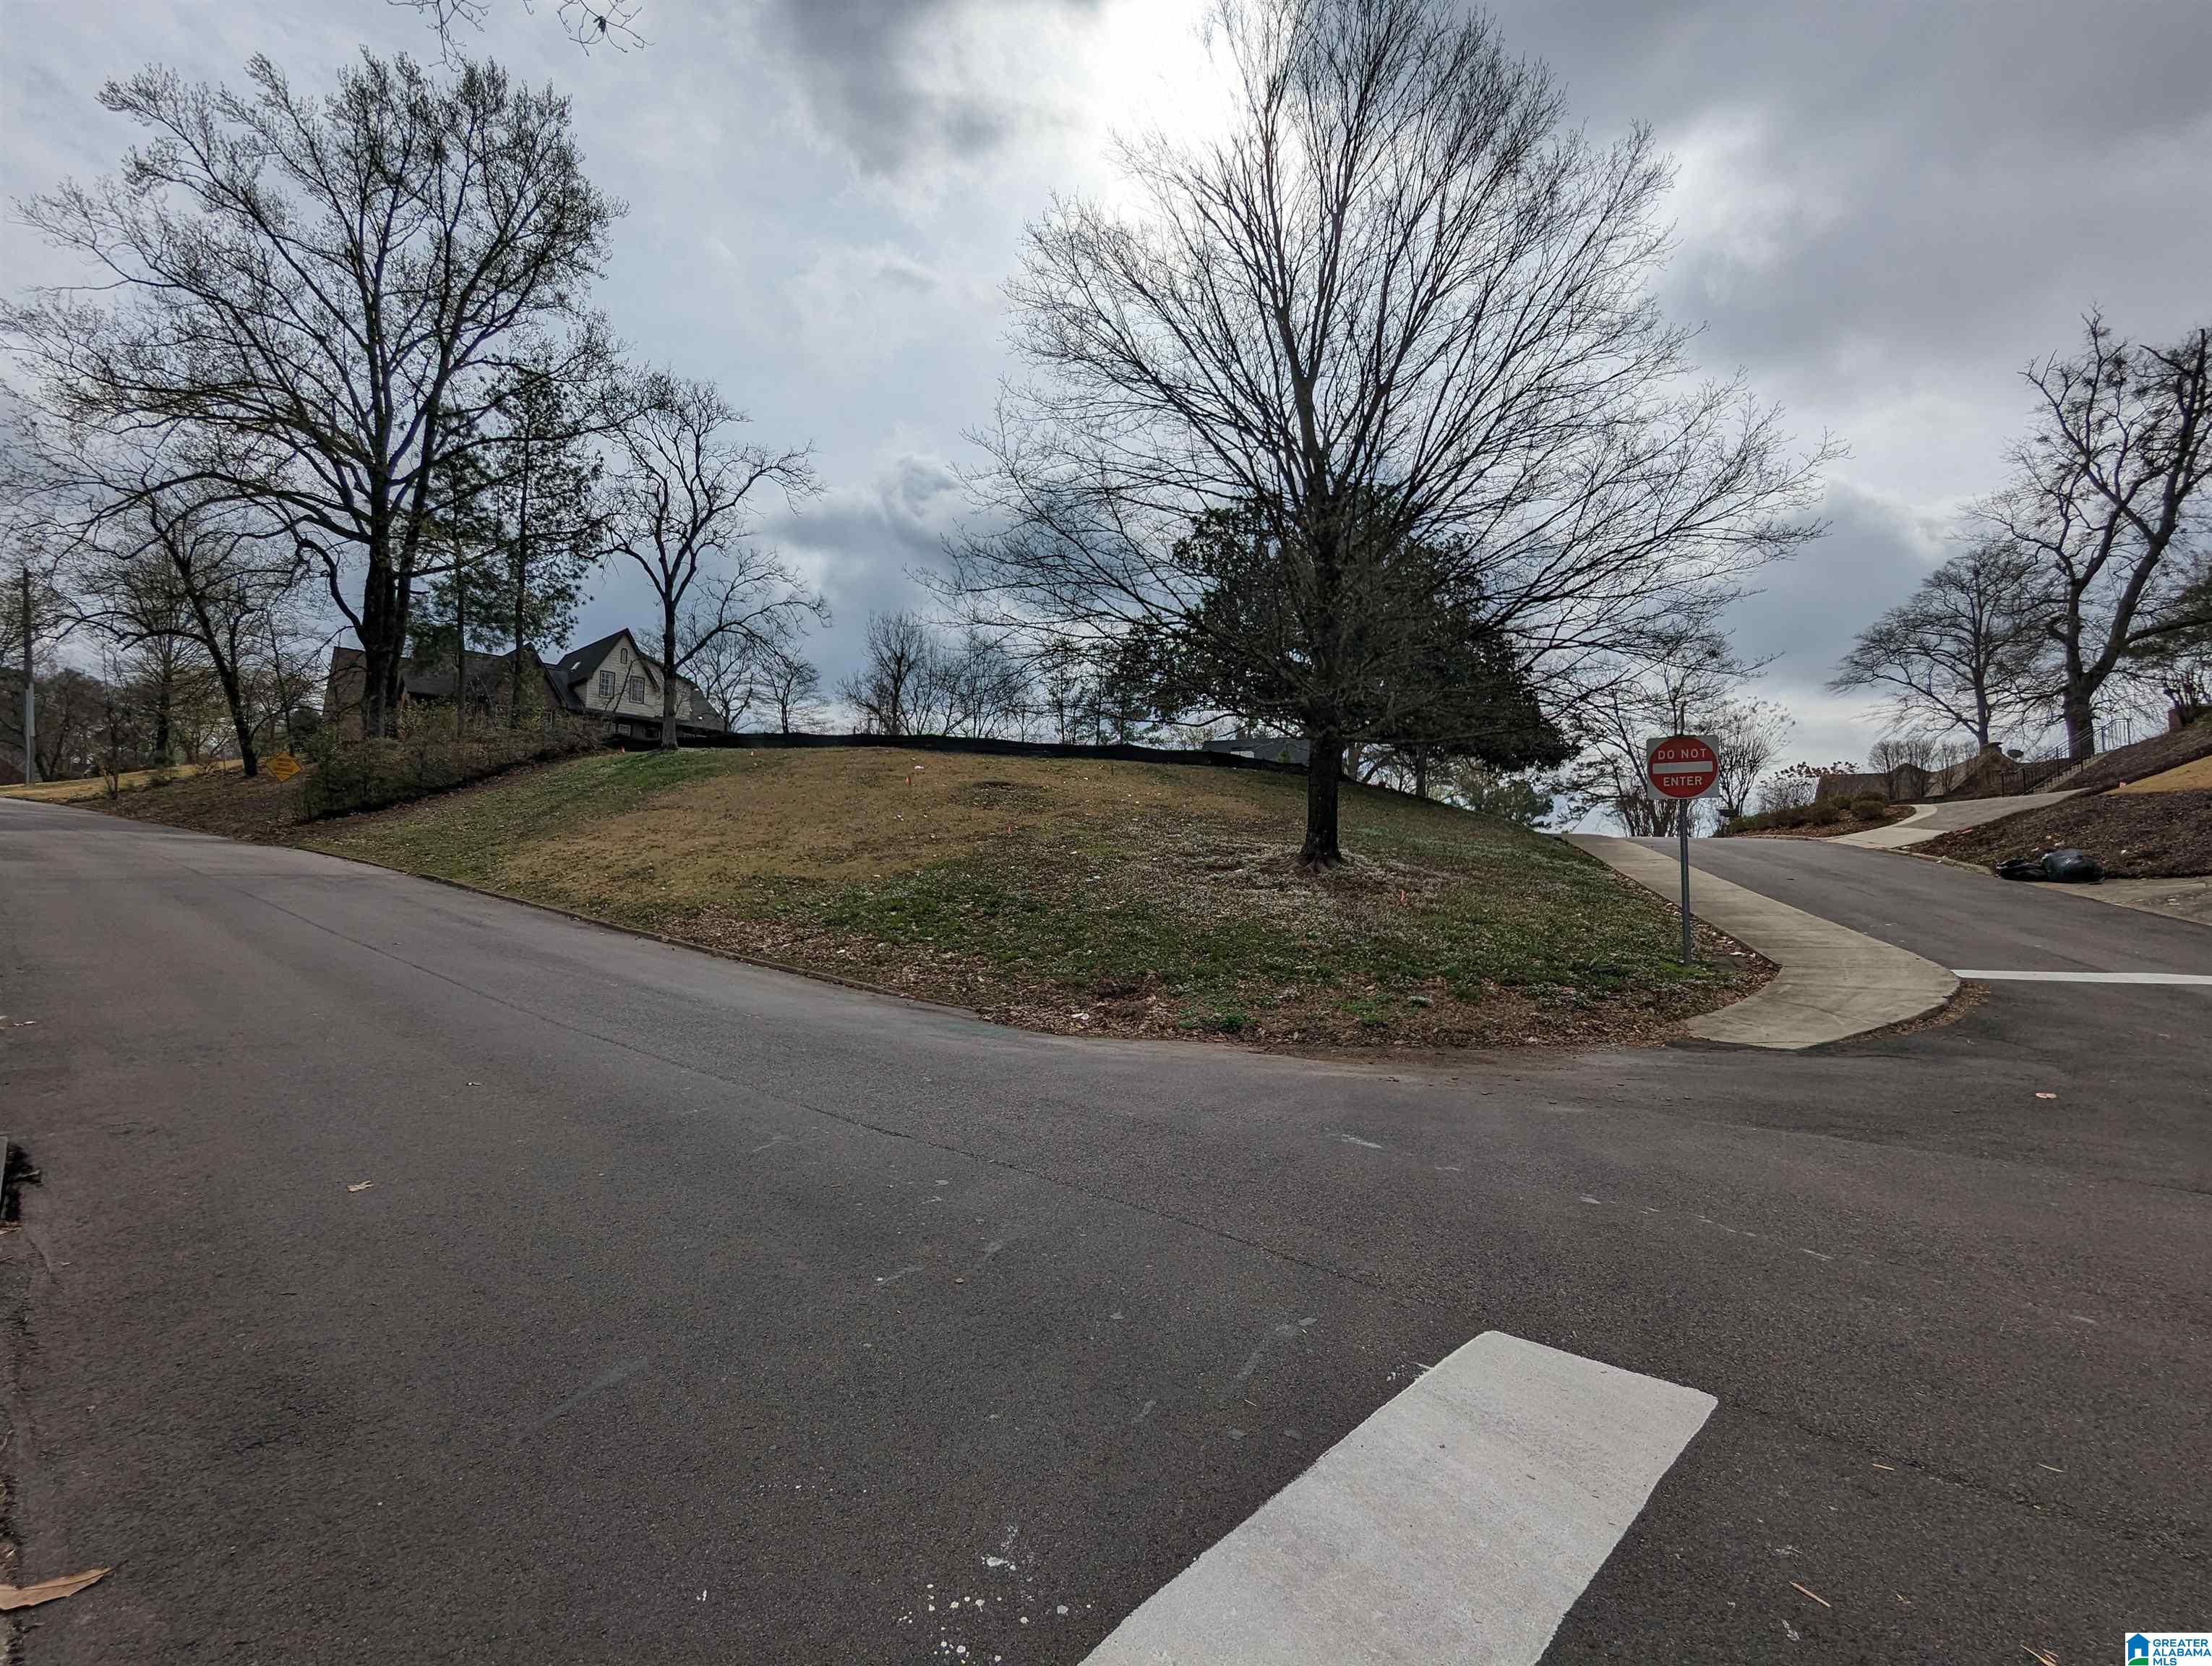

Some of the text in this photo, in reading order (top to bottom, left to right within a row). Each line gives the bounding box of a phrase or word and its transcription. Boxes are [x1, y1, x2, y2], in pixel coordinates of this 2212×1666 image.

[1658, 748, 1707, 760] DO NOT
[1663, 776, 1702, 787] ENTER
